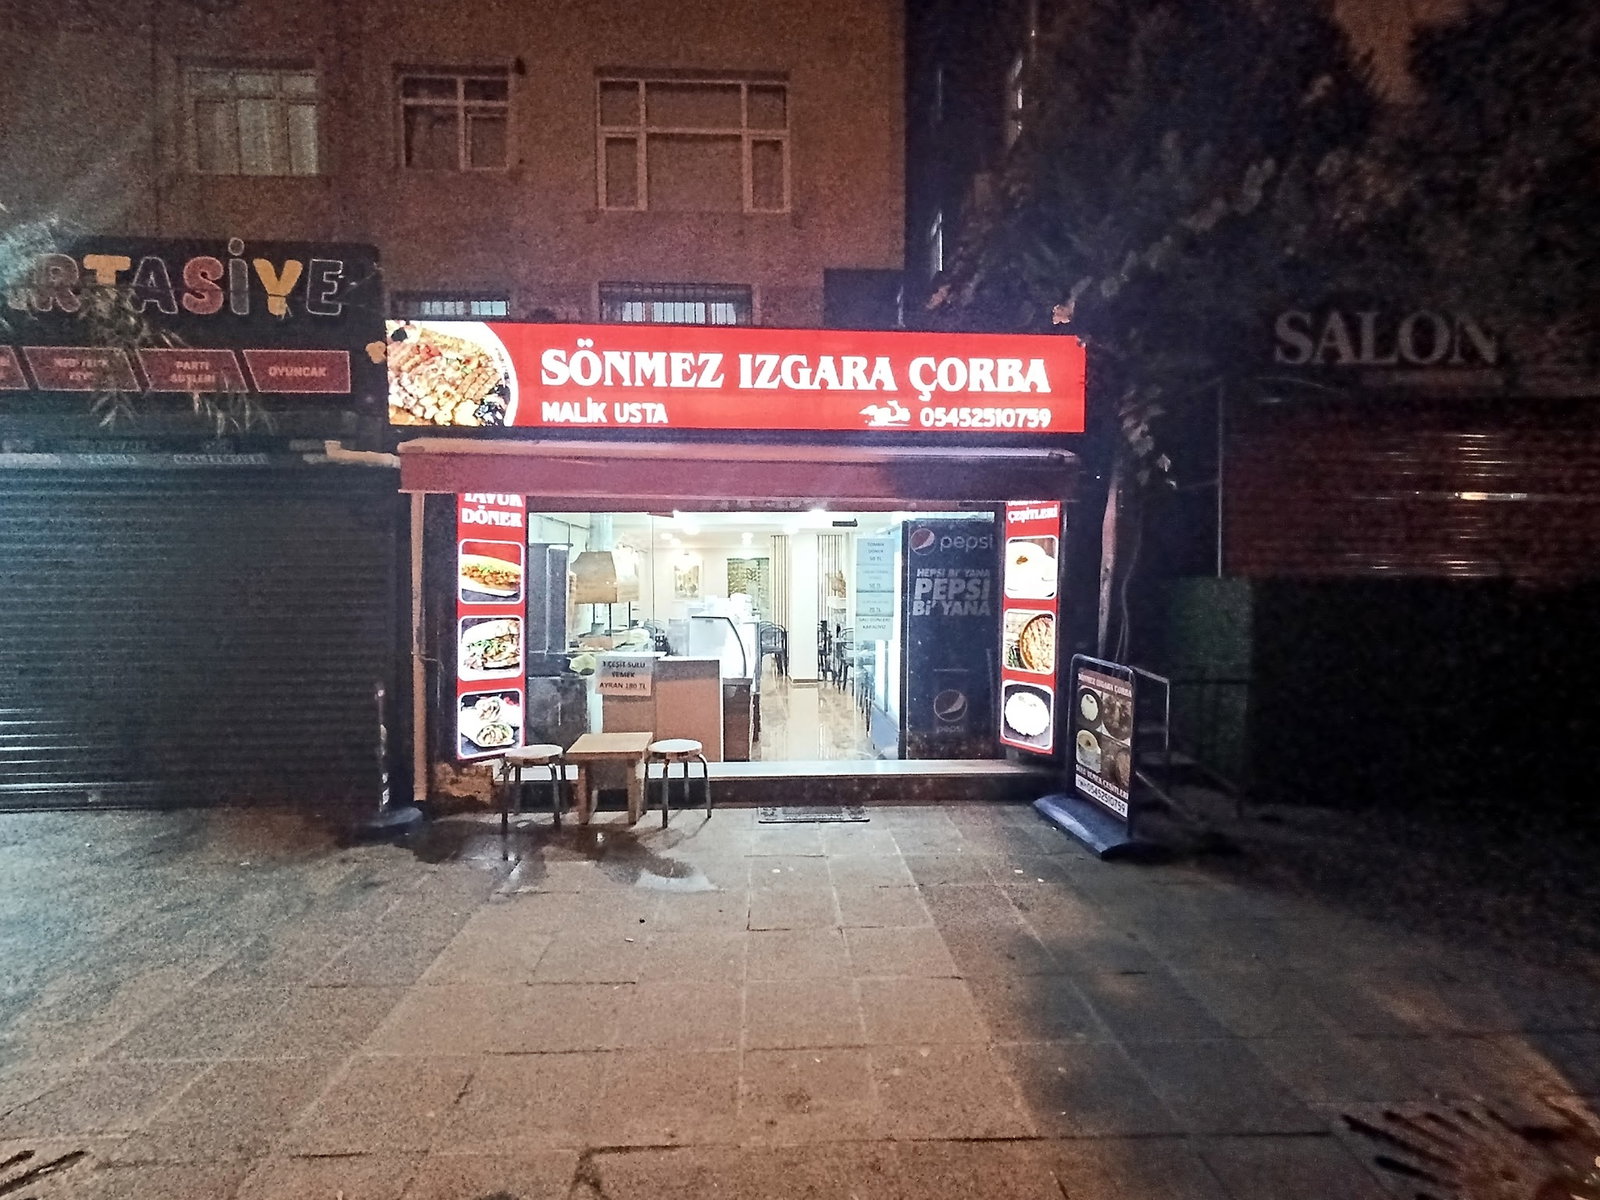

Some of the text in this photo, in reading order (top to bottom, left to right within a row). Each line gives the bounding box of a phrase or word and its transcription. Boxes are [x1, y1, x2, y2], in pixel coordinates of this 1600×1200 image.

[8, 237, 344, 317] RTASİYE
[1274, 309, 1498, 365] SALON
[268, 366, 328, 377] OYUNCAK
[541, 338, 1052, 402] SÖNMEZ IZGARA ÇORBA
[541, 397, 669, 424] MALİK USTA
[919, 406, 1052, 428] 05452510759
[461, 504, 523, 527] DÖNER
[940, 533, 993, 552] pepsi
[914, 578, 990, 600] PEPSI
[941, 601, 991, 616] YANA
